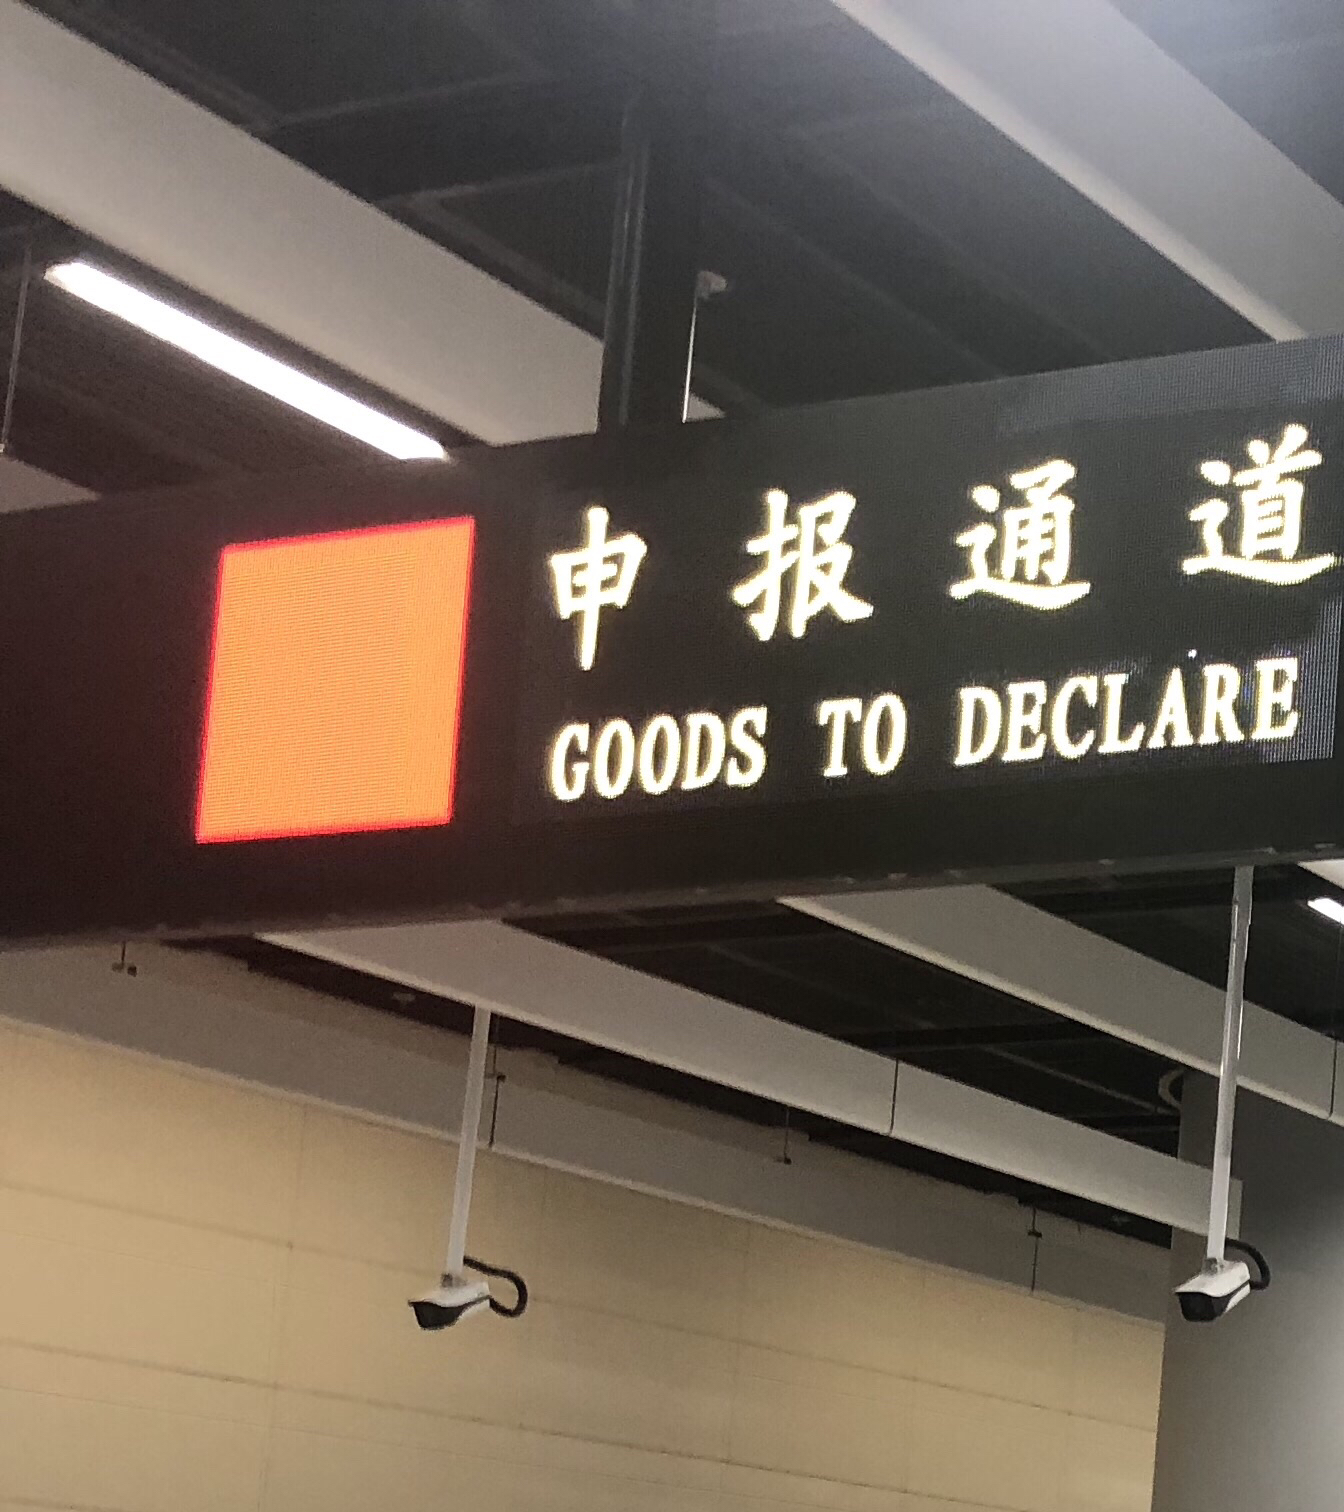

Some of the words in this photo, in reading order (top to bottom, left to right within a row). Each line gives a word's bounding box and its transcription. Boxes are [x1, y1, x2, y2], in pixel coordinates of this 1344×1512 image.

[547, 422, 1344, 671] 申报通道
[550, 705, 768, 803] GOODS
[816, 692, 908, 778] TO
[952, 656, 1301, 766] DECLARE
